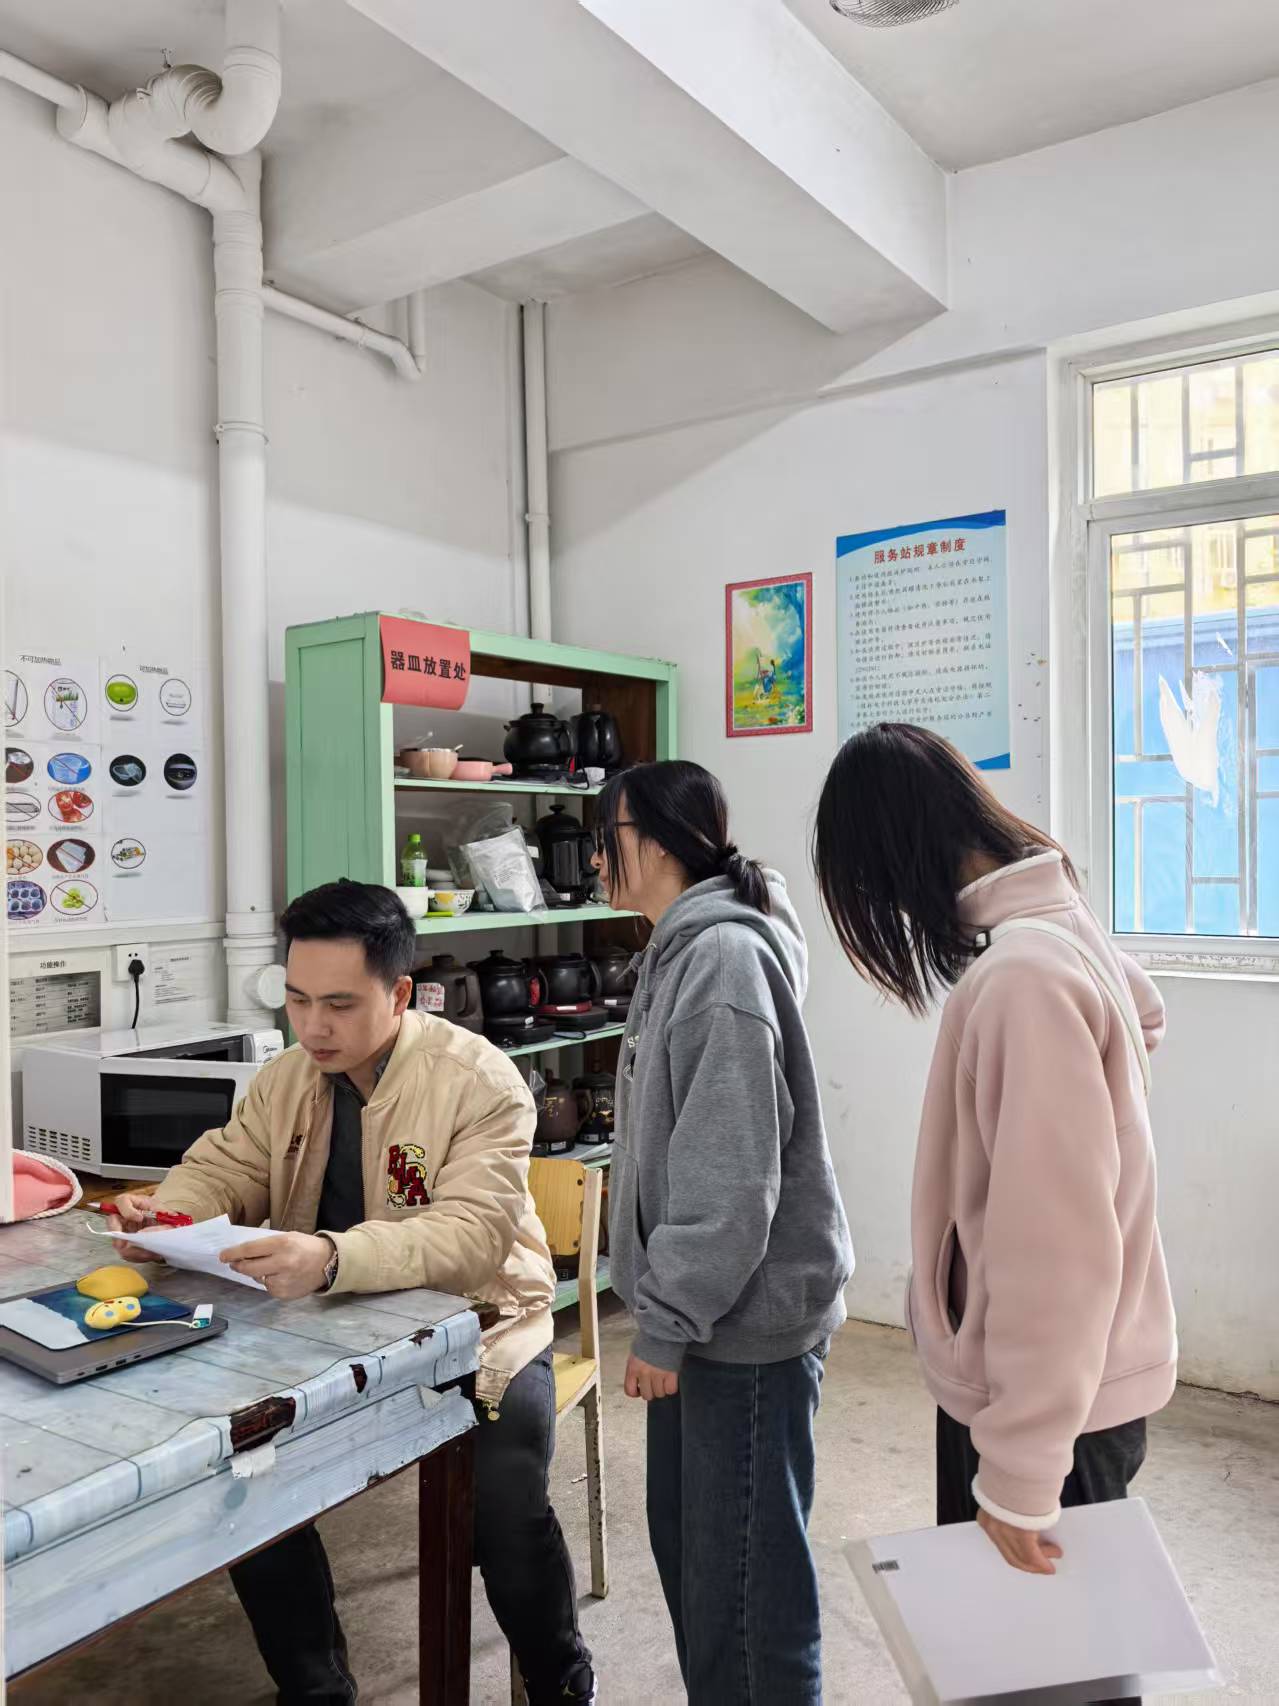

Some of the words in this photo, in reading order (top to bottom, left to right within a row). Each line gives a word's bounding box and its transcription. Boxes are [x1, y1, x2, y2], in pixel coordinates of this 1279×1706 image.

[874, 537, 967, 564] 服务站规章制度
[391, 650, 466, 681] 器皿放置处
